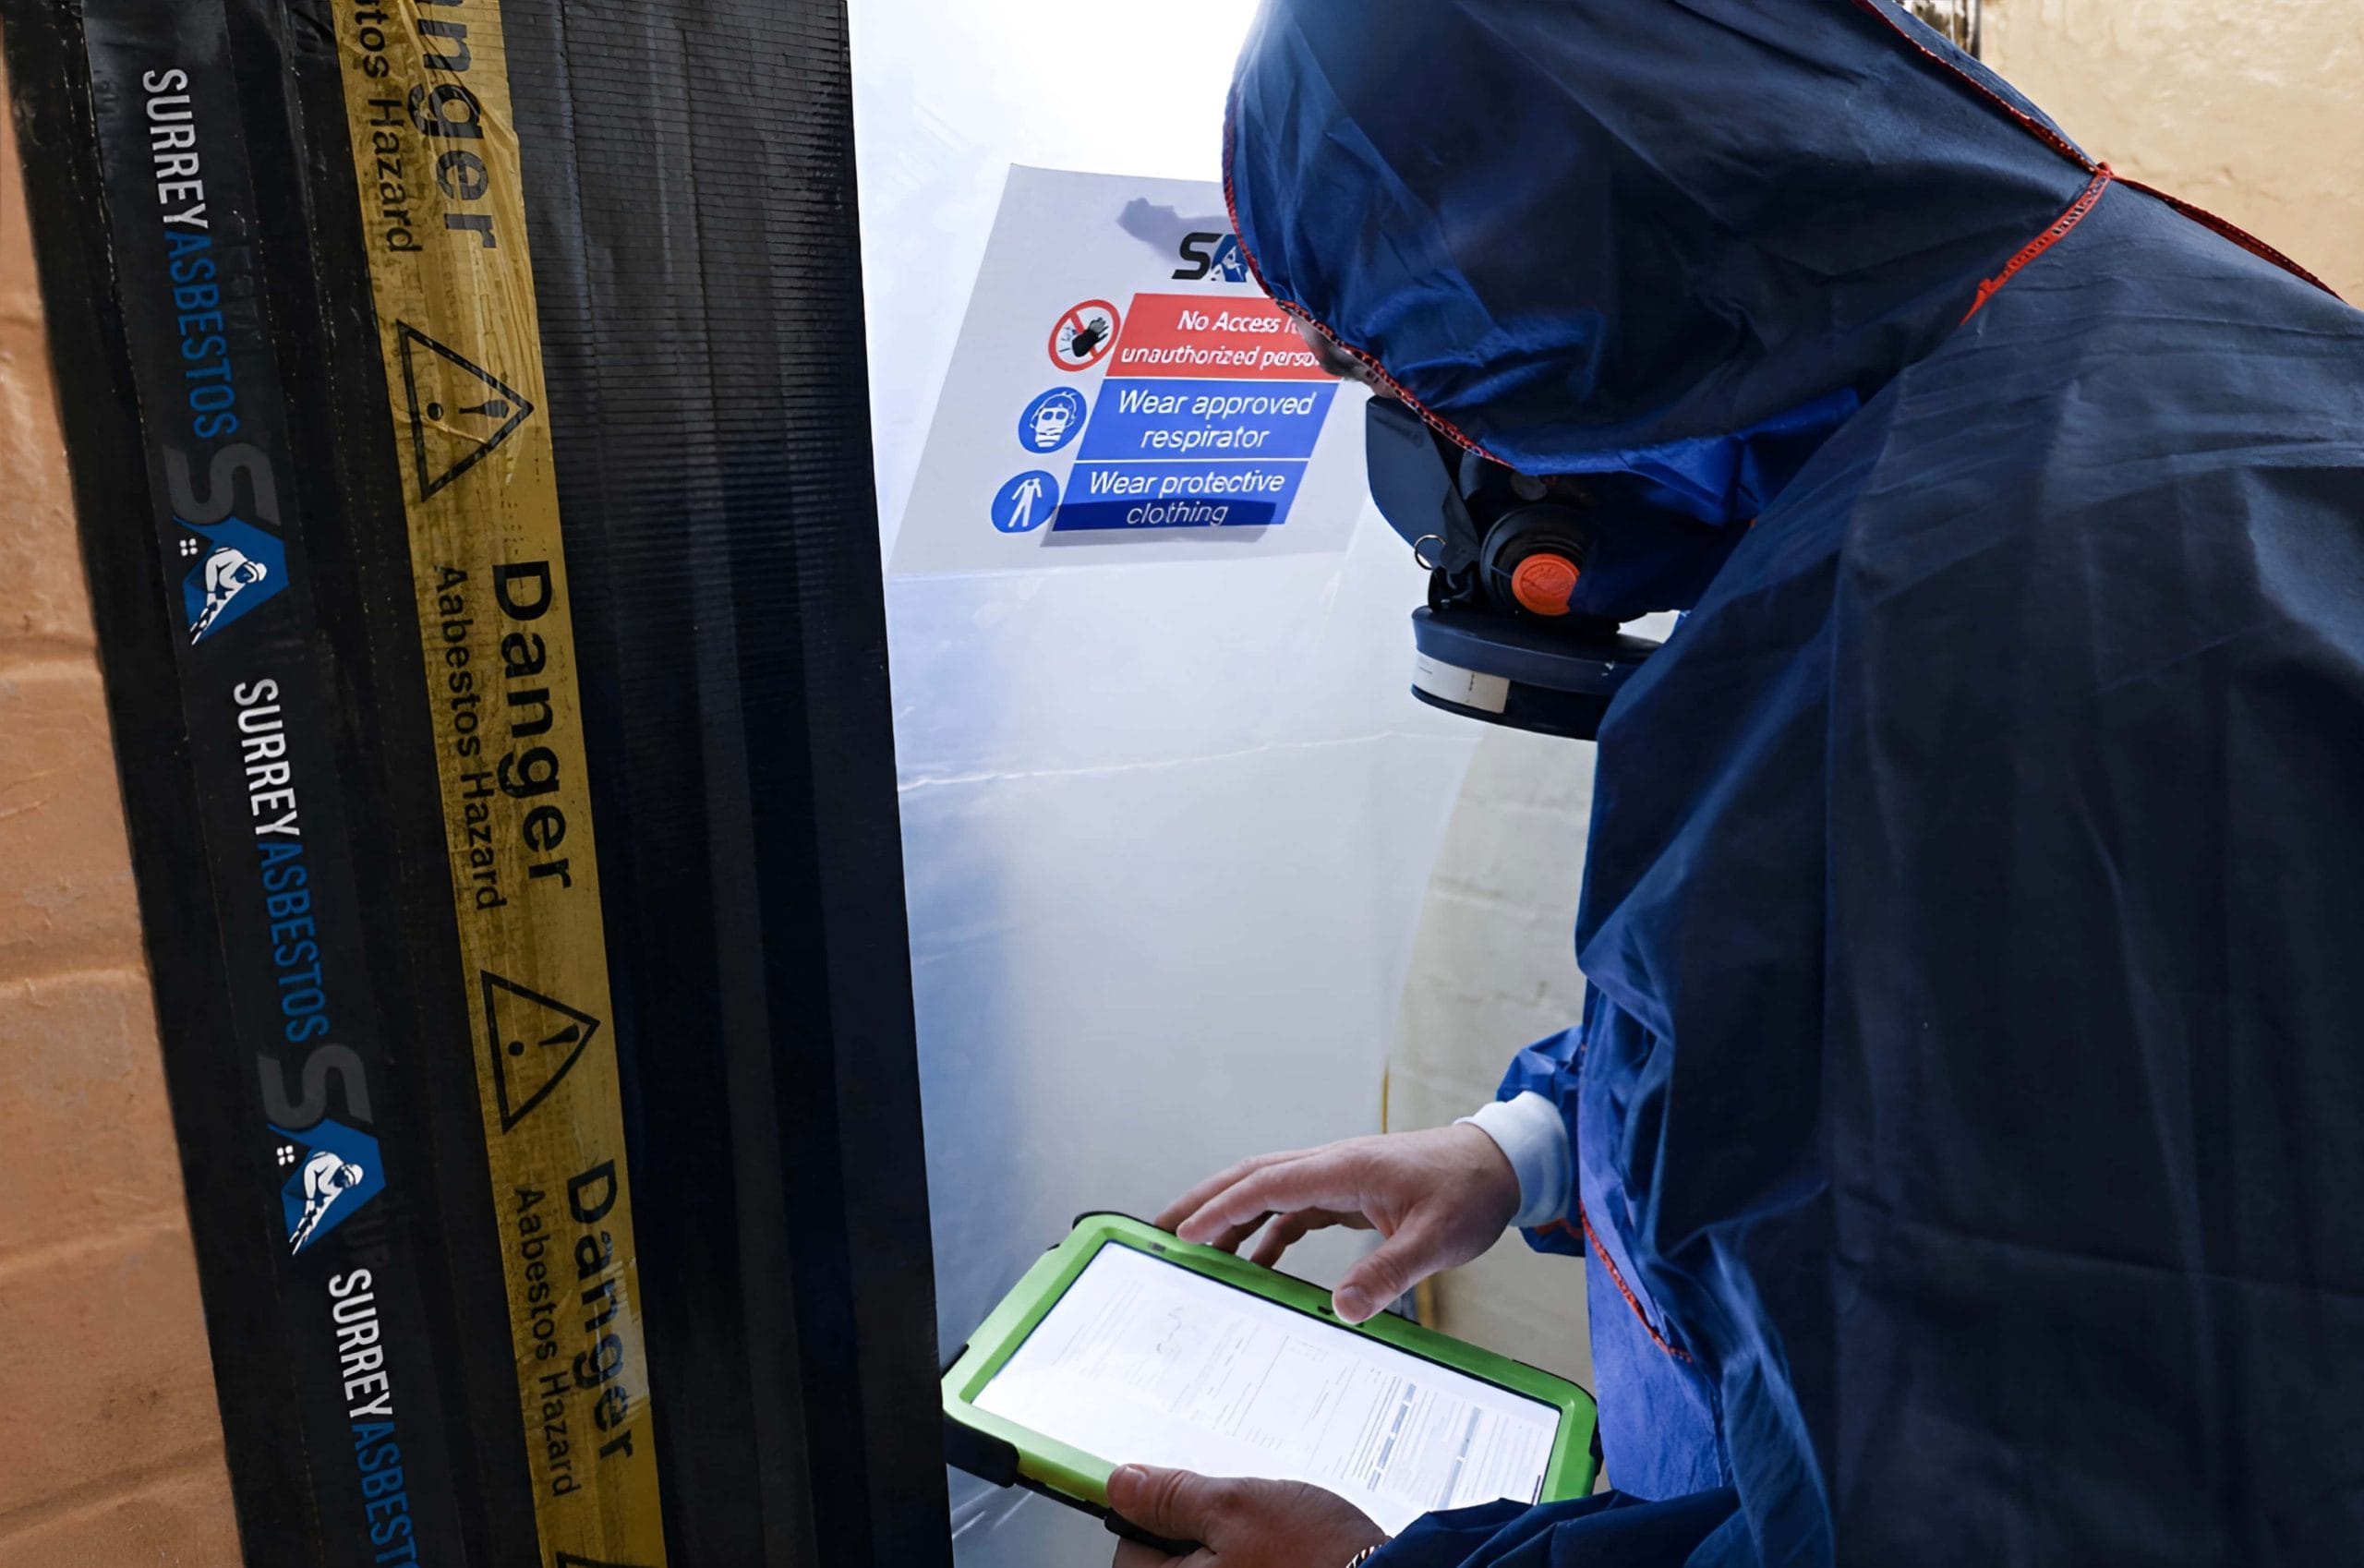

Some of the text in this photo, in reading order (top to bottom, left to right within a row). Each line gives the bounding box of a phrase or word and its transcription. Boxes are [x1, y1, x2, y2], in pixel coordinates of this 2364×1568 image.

[368, 98, 423, 252] Hazard
[407, 0, 498, 248] nger
[1121, 345, 1320, 371] unauthorized perso
[1176, 310, 1209, 331] No
[1212, 312, 1282, 333] Access
[1118, 390, 1317, 419] Wear approved
[1140, 425, 1270, 452] respirator
[1090, 470, 1285, 499] Wear protective
[1127, 501, 1229, 526] clothing
[492, 561, 573, 888] Danger
[461, 772, 508, 911] Hazard
[567, 1159, 633, 1458] Danger
[328, 1268, 422, 1568] SURREYASBEST
[539, 1370, 582, 1498] Hazard
